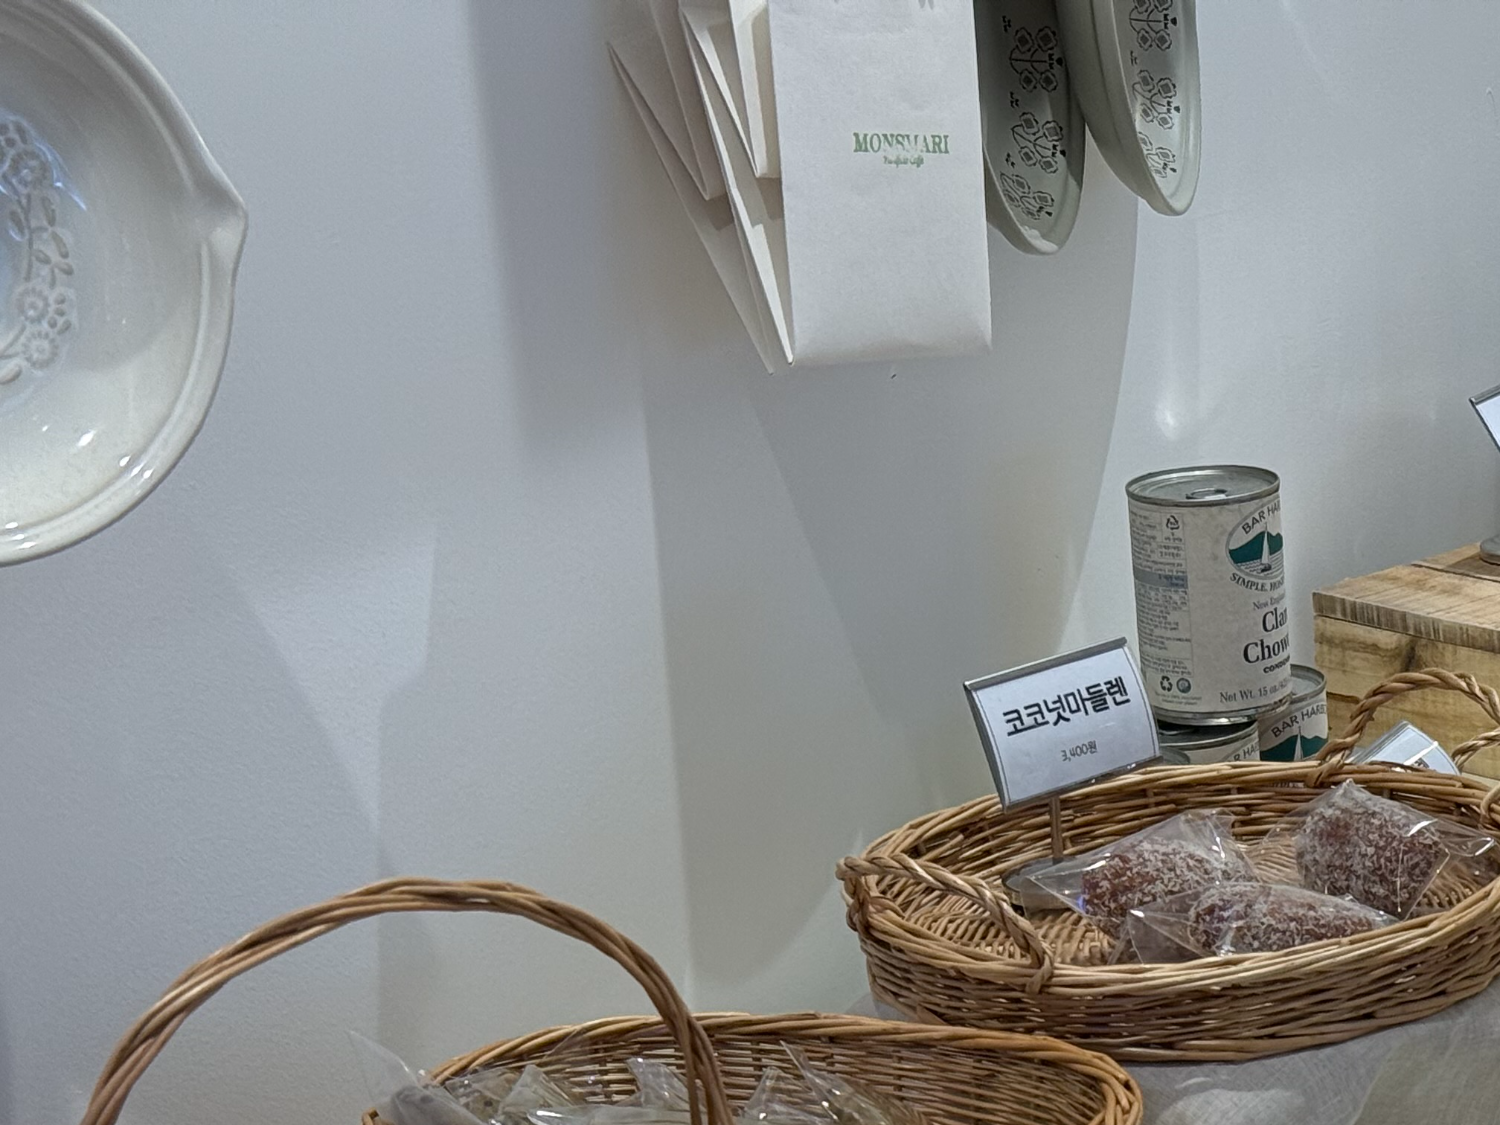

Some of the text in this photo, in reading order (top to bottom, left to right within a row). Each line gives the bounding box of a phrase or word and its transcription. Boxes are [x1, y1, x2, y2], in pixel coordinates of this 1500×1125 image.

[853, 132, 950, 154] MONSMARI
[1242, 510, 1266, 534] BAR
[1002, 676, 1131, 737] 코코넛마들렌
[1271, 715, 1299, 738] BAR
[1060, 740, 1098, 762] 3,400원
